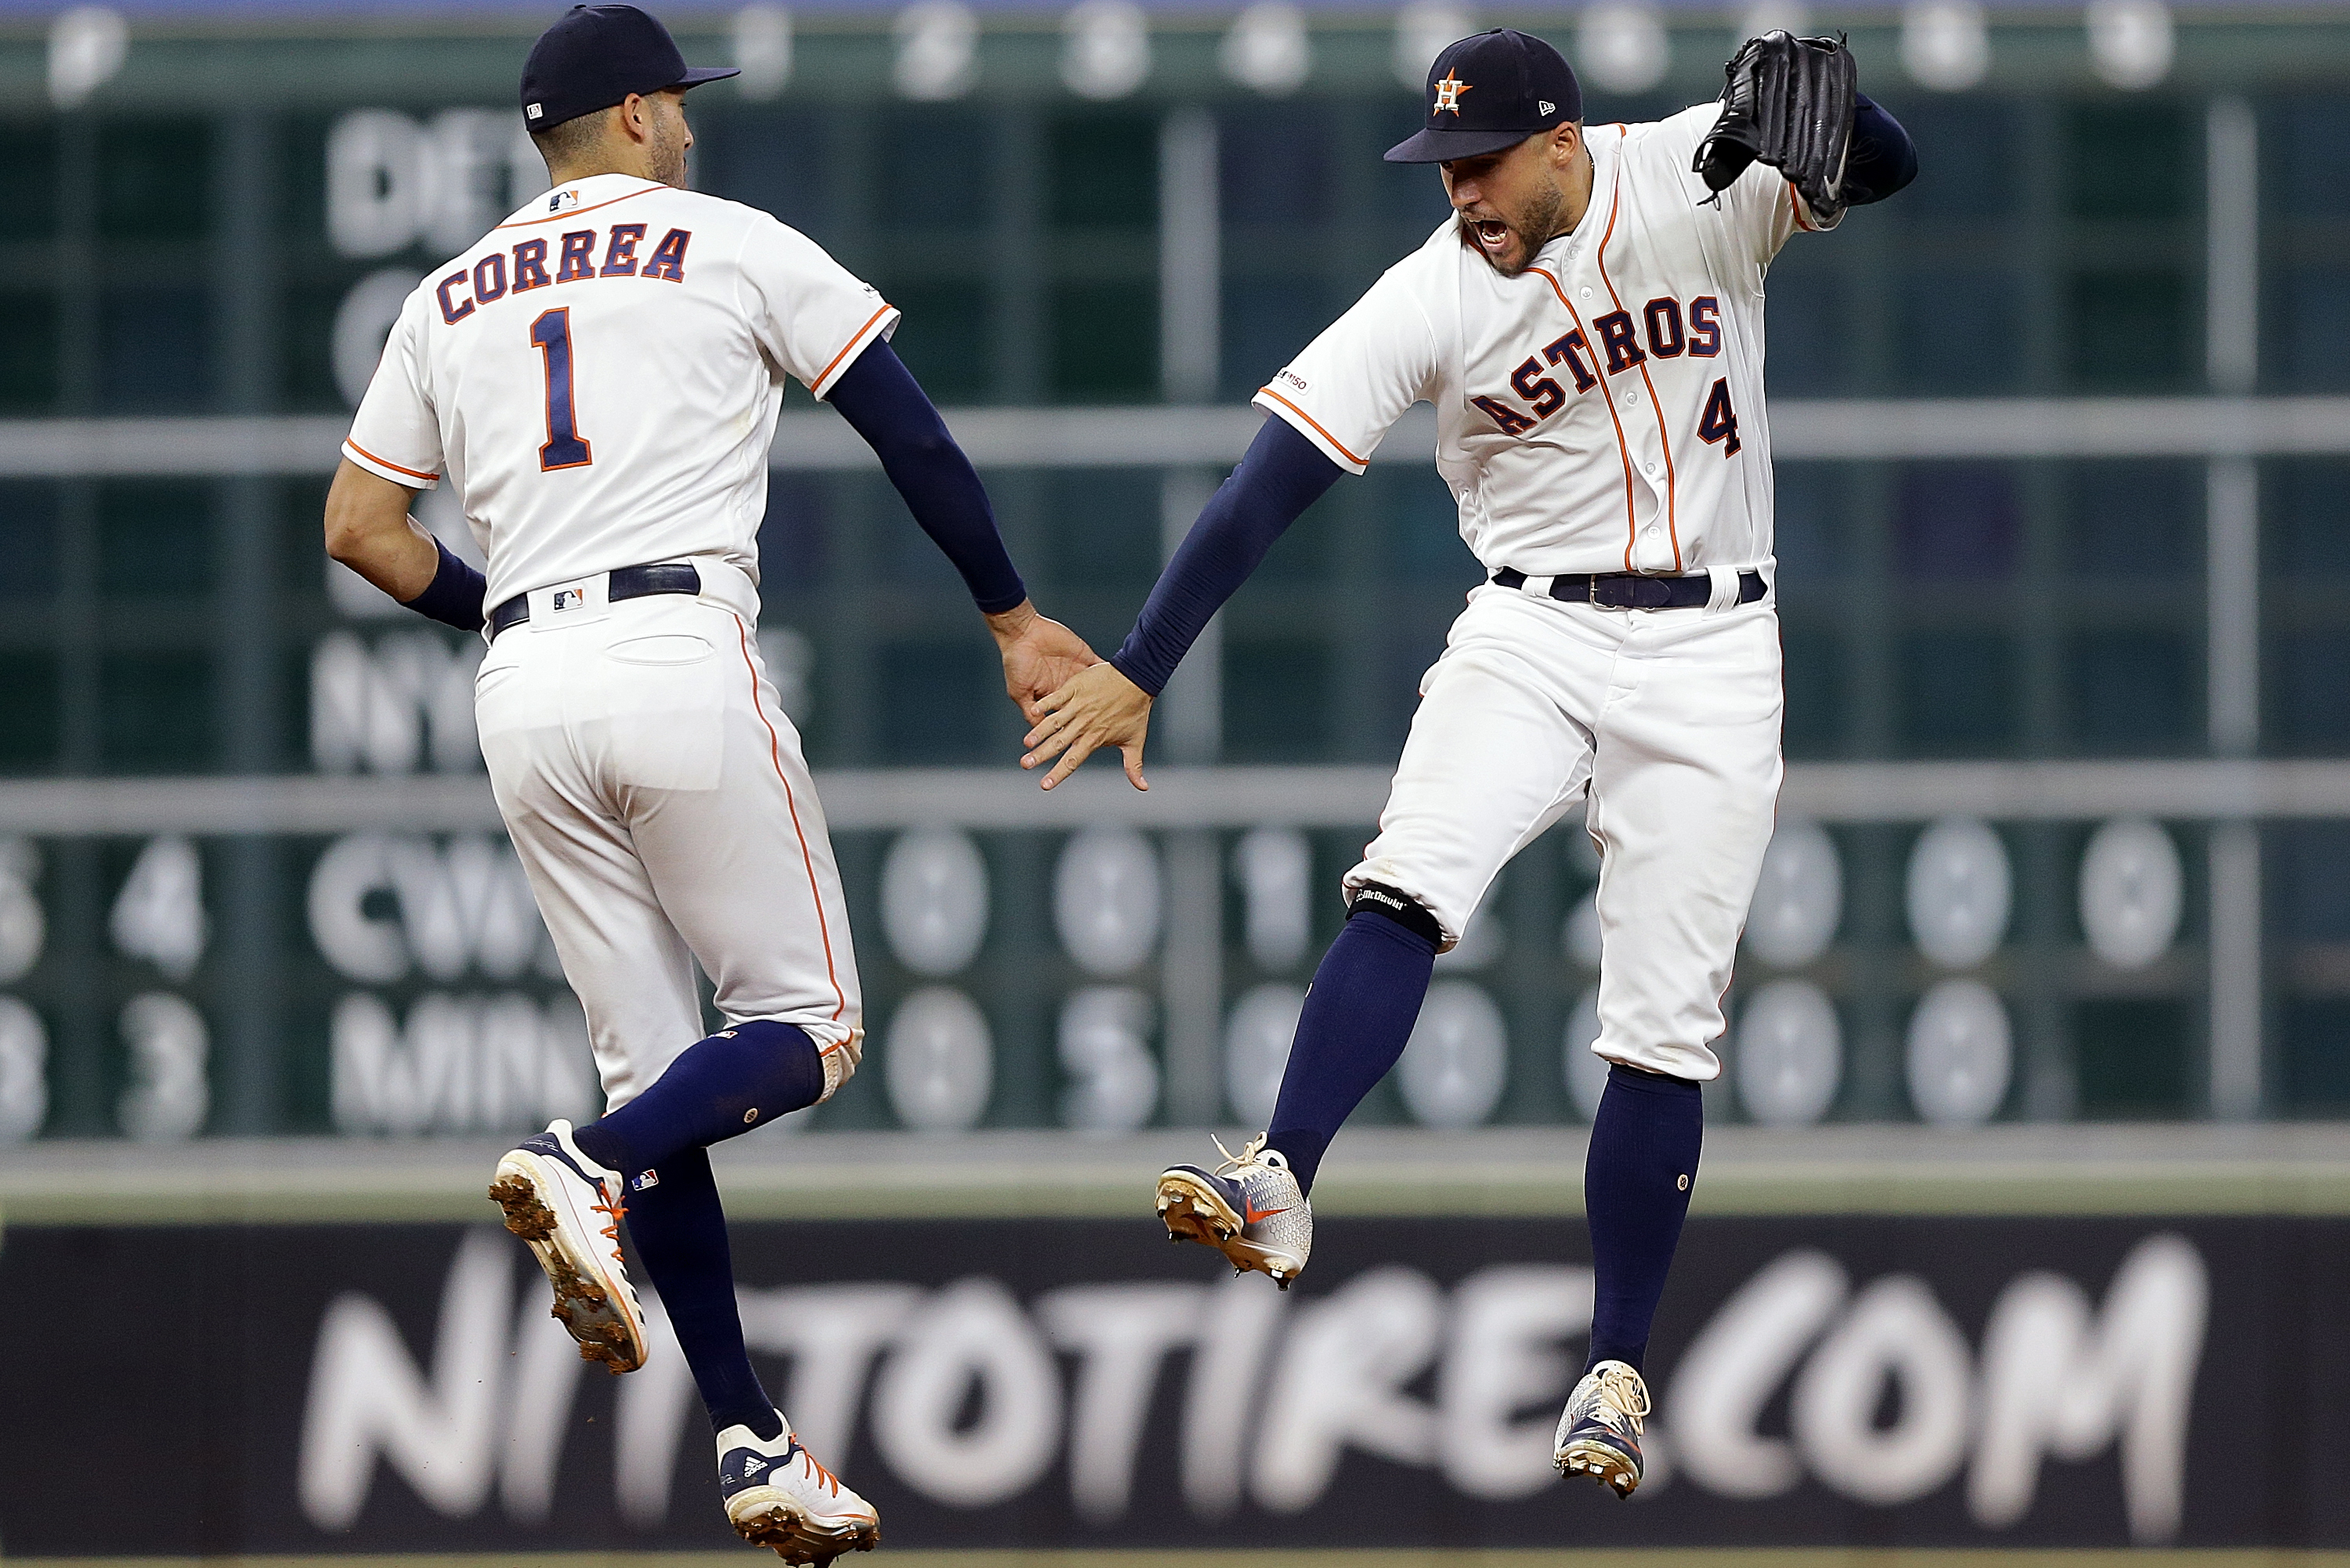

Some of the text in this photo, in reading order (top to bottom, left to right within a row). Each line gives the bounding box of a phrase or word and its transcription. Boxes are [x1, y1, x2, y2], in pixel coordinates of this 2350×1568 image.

[1434, 80, 1462, 110] H
[436, 223, 692, 325] CORREA
[530, 306, 592, 471] 1
[1472, 295, 1720, 435] ASTROS
[1697, 376, 1741, 458] 4
